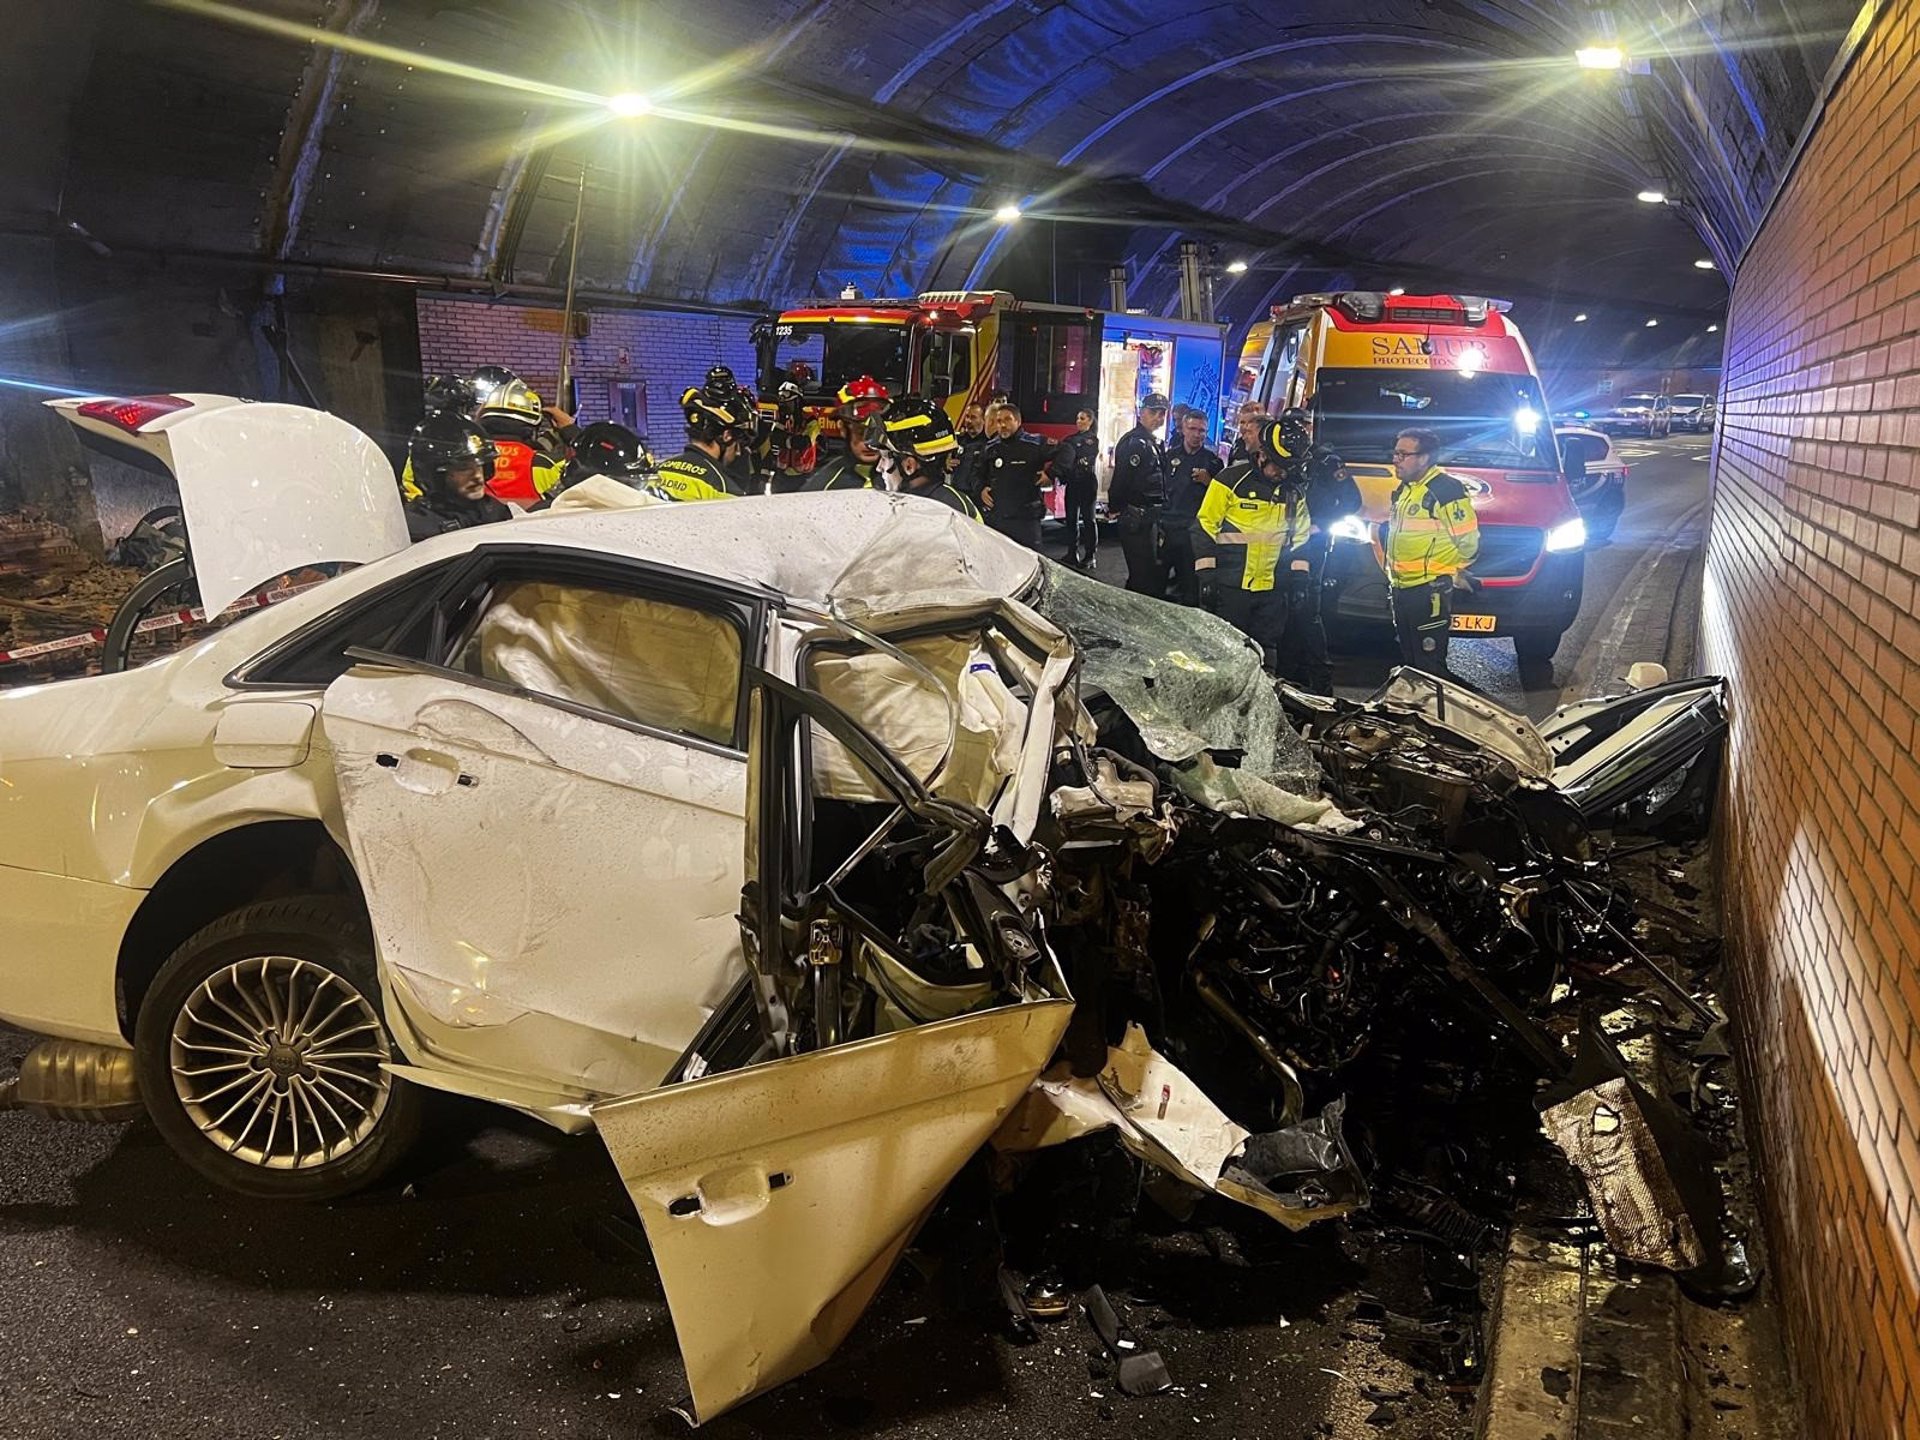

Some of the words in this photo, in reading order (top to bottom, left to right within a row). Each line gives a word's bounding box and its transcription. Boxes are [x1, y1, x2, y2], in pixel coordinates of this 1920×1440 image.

[776, 325, 793, 336] 1235
[1372, 336, 1490, 360] SAMUR
[657, 478, 688, 492] ADRID
[1465, 616, 1493, 630] LKJ
